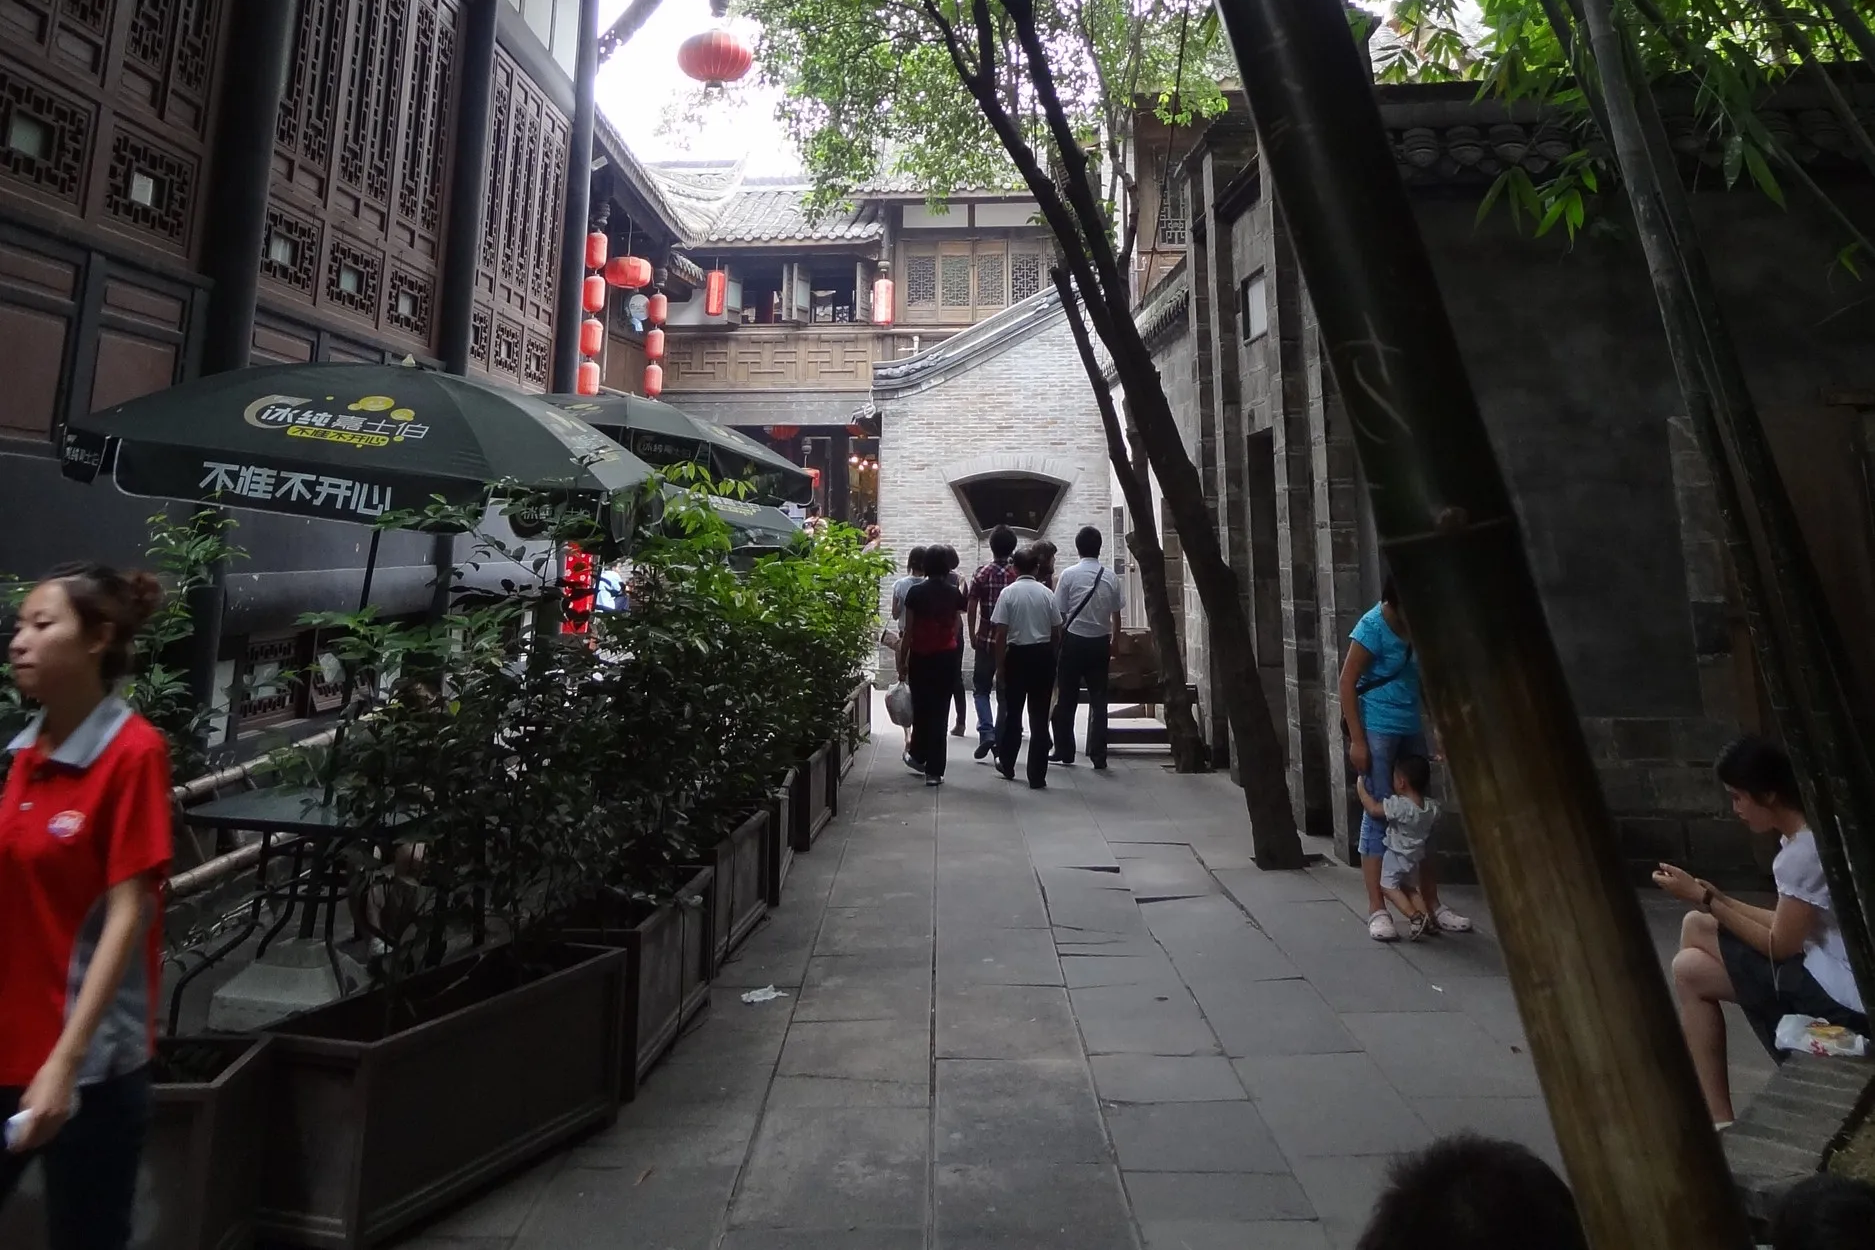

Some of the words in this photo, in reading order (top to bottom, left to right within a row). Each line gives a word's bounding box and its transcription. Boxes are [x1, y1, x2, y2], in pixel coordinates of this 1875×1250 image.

[260, 405, 431, 439] 冰纯嘉士伯
[292, 426, 387, 445] 不准不开心
[198, 461, 392, 517] 不准不开心
